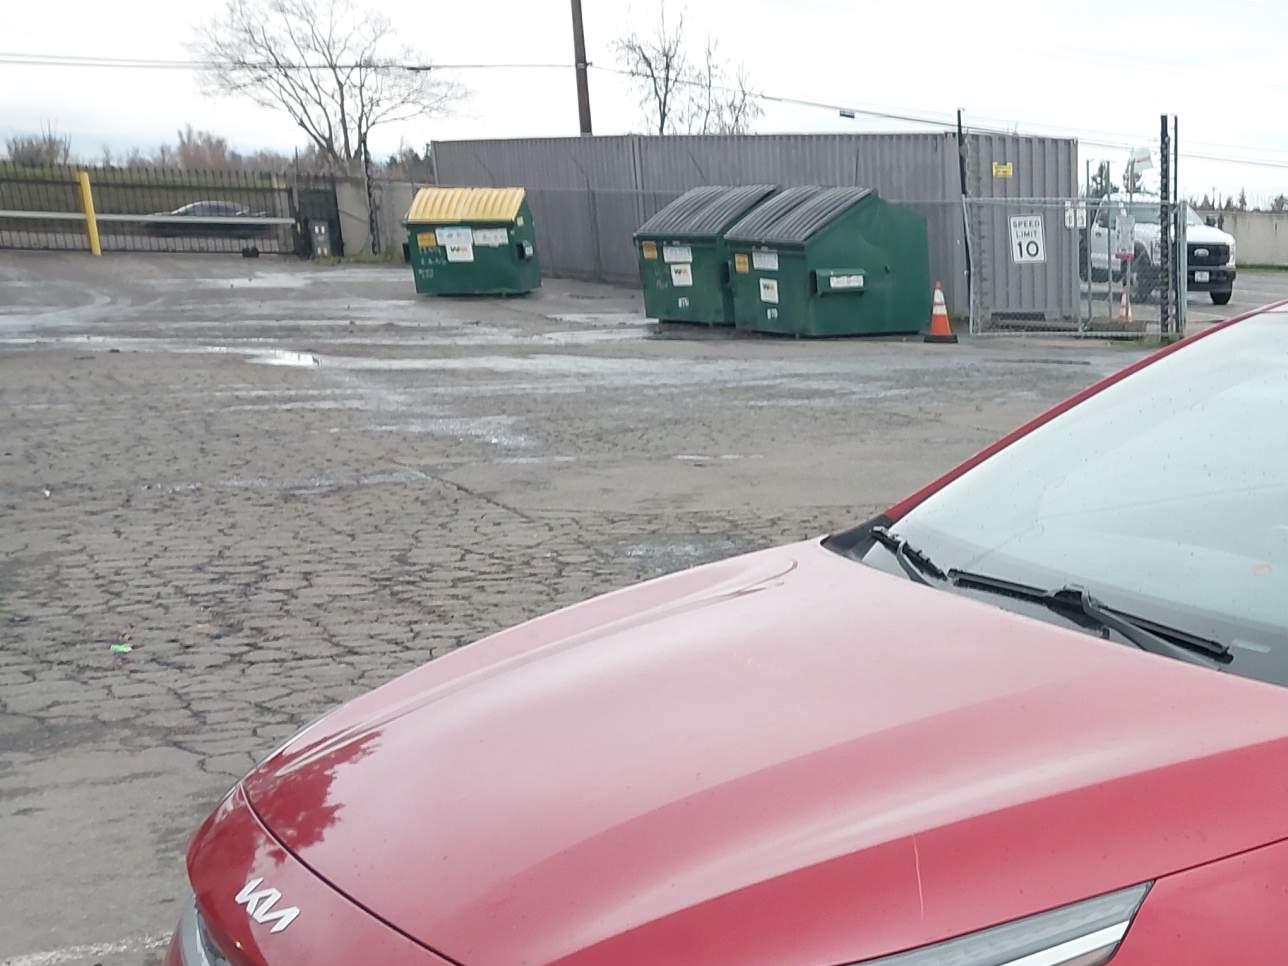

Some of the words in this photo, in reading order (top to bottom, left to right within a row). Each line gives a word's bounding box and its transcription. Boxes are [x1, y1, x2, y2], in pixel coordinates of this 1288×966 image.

[1012, 220, 1040, 228] SPEED
[1016, 230, 1037, 239] LIMIT
[1017, 240, 1039, 258] 10
[235, 877, 300, 933] KIA
